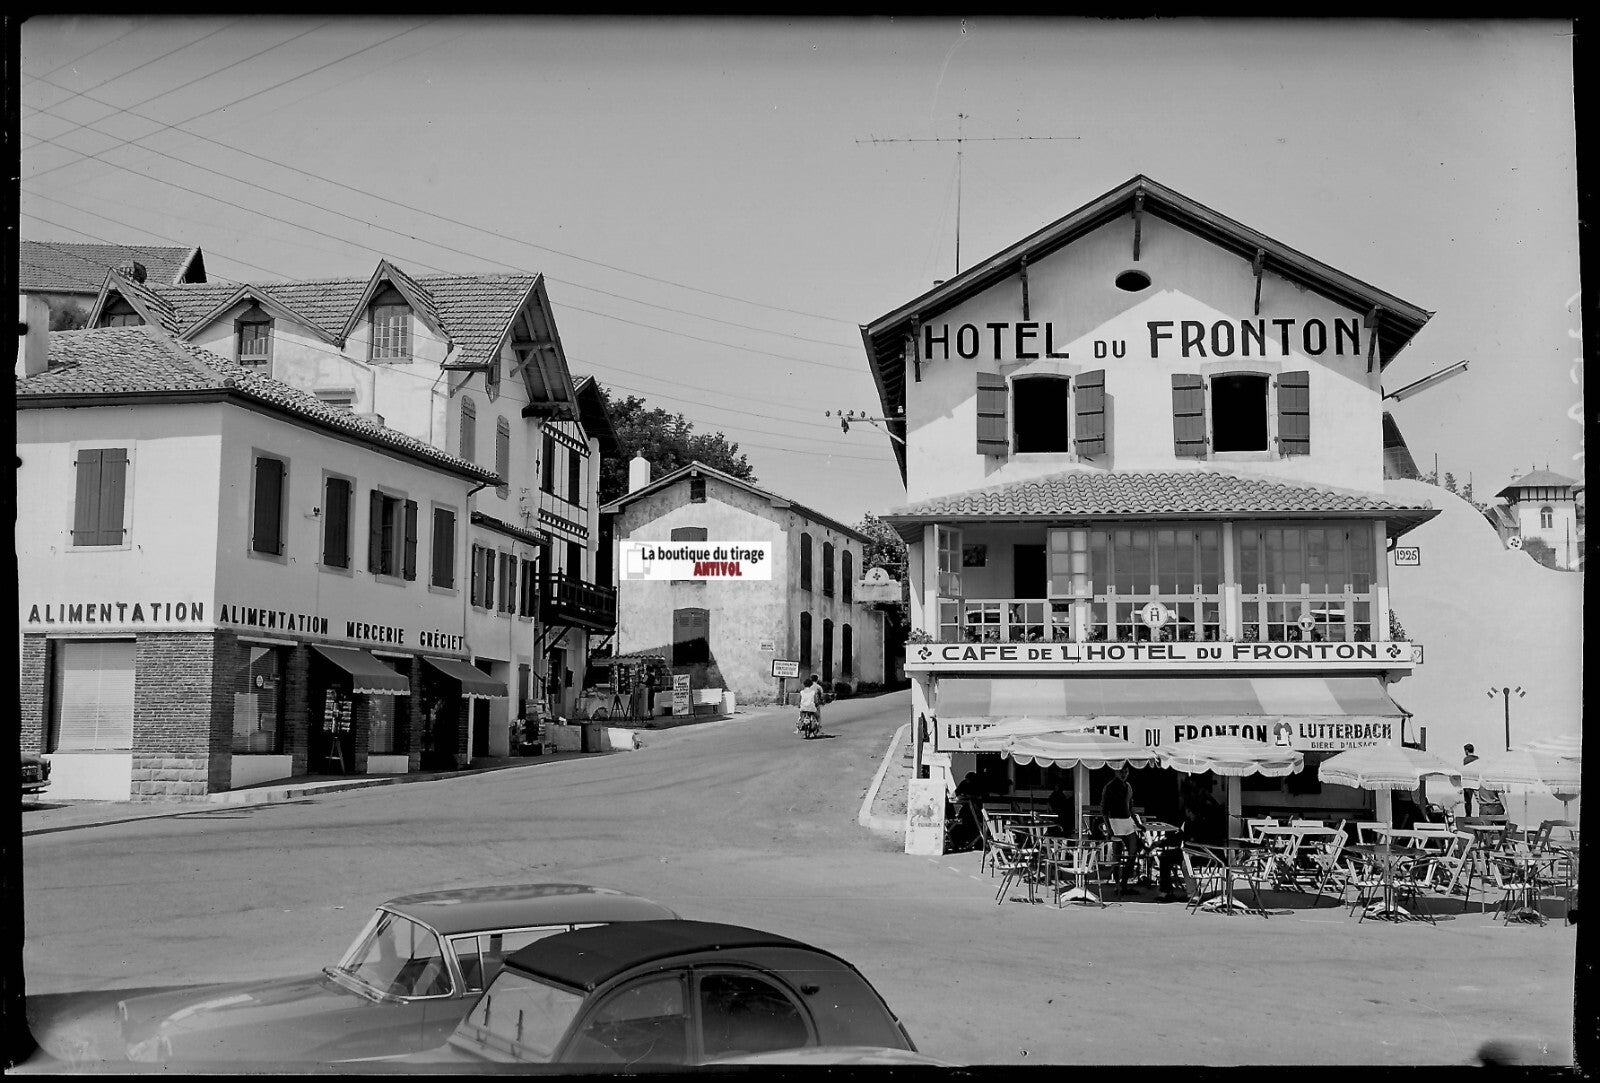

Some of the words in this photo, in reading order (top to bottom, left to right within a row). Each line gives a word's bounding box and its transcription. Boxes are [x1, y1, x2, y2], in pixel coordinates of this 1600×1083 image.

[924, 322, 1070, 360] HOTEL
[1093, 340, 1127, 359] DU
[1146, 318, 1361, 359] FRONTON
[1396, 550, 1418, 561] 1925
[28, 601, 204, 623] ALIMENTATION
[219, 604, 329, 635] ALIMENTATION
[346, 620, 405, 645] MERCERIE
[419, 629, 464, 651] GRÉCIET
[941, 646, 1018, 661] CAFE
[1028, 648, 1053, 661] DE
[1196, 647, 1223, 660] DU
[1232, 644, 1378, 660] FRONTON
[1144, 728, 1161, 747] DU
[1299, 723, 1392, 740] LUTTERBACH
